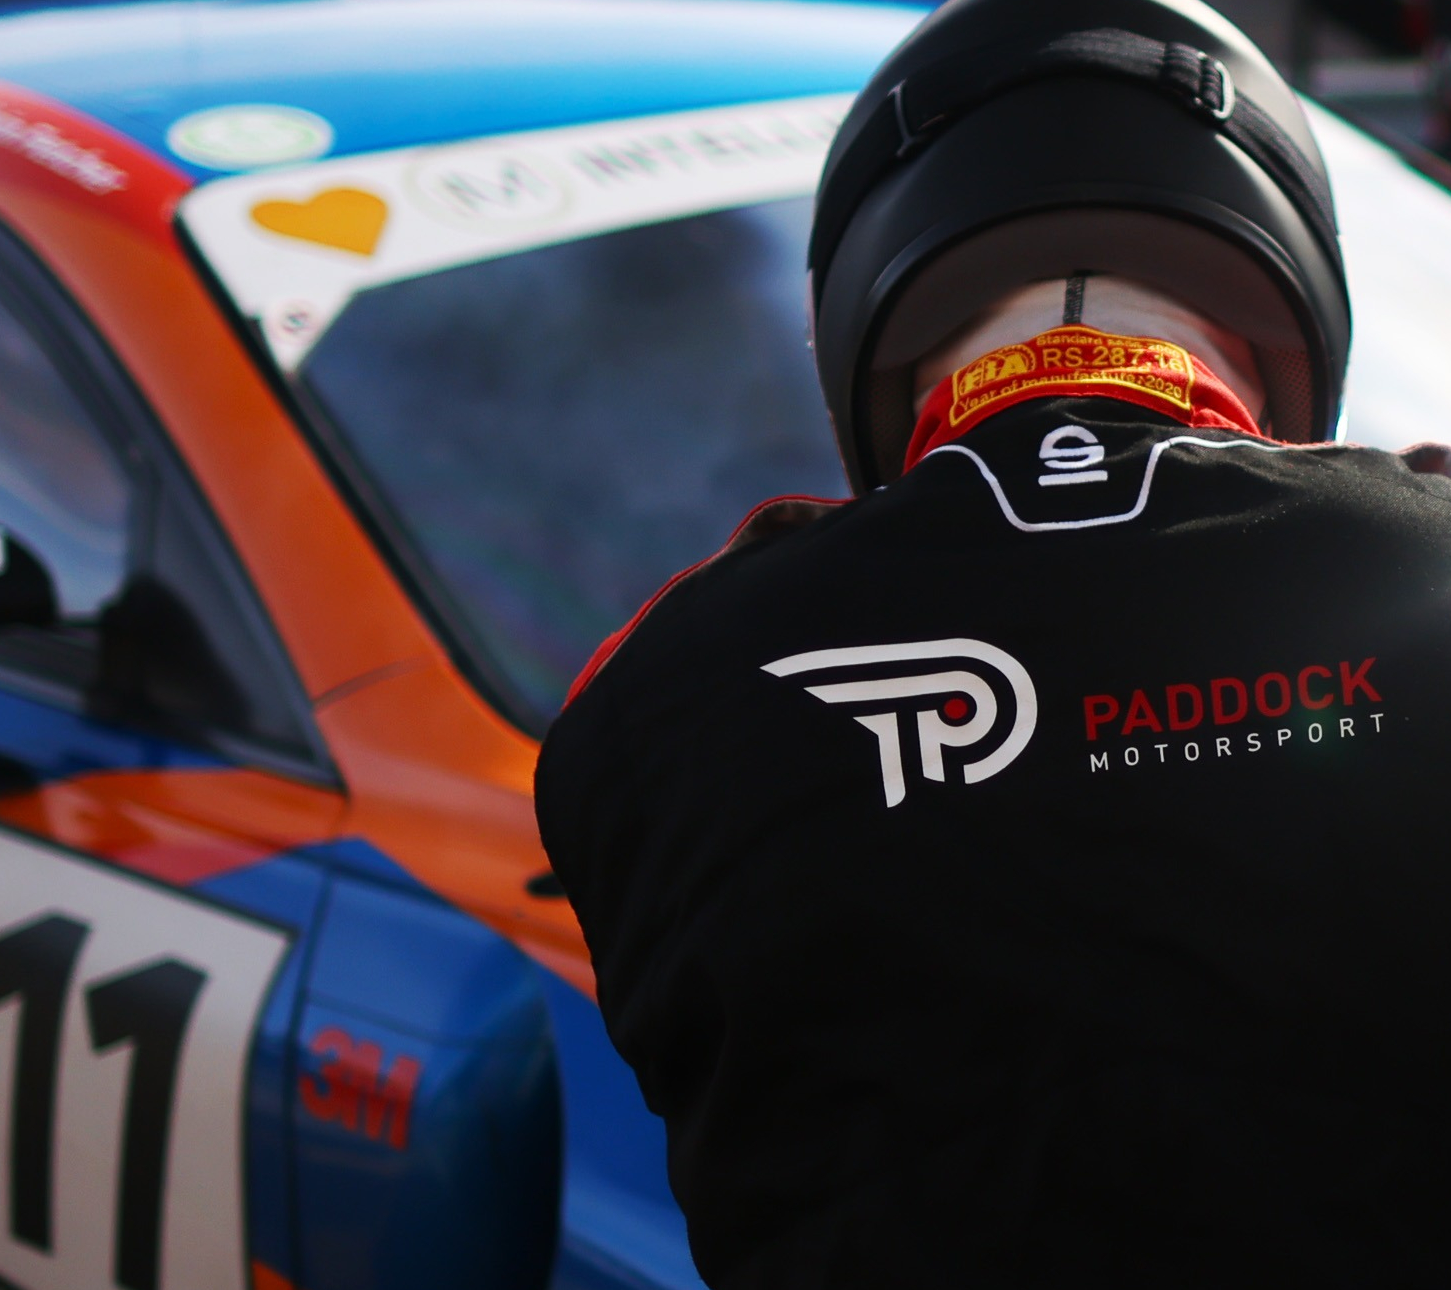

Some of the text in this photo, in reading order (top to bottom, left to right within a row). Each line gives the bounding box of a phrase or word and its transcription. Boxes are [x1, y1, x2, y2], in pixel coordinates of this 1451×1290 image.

[959, 389, 998, 411] Year
[1000, 379, 1020, 396] of
[1082, 656, 1384, 742] PADDOCK
[1089, 712, 1386, 774] MOTORSPORT
[297, 1026, 422, 1152] 3M
